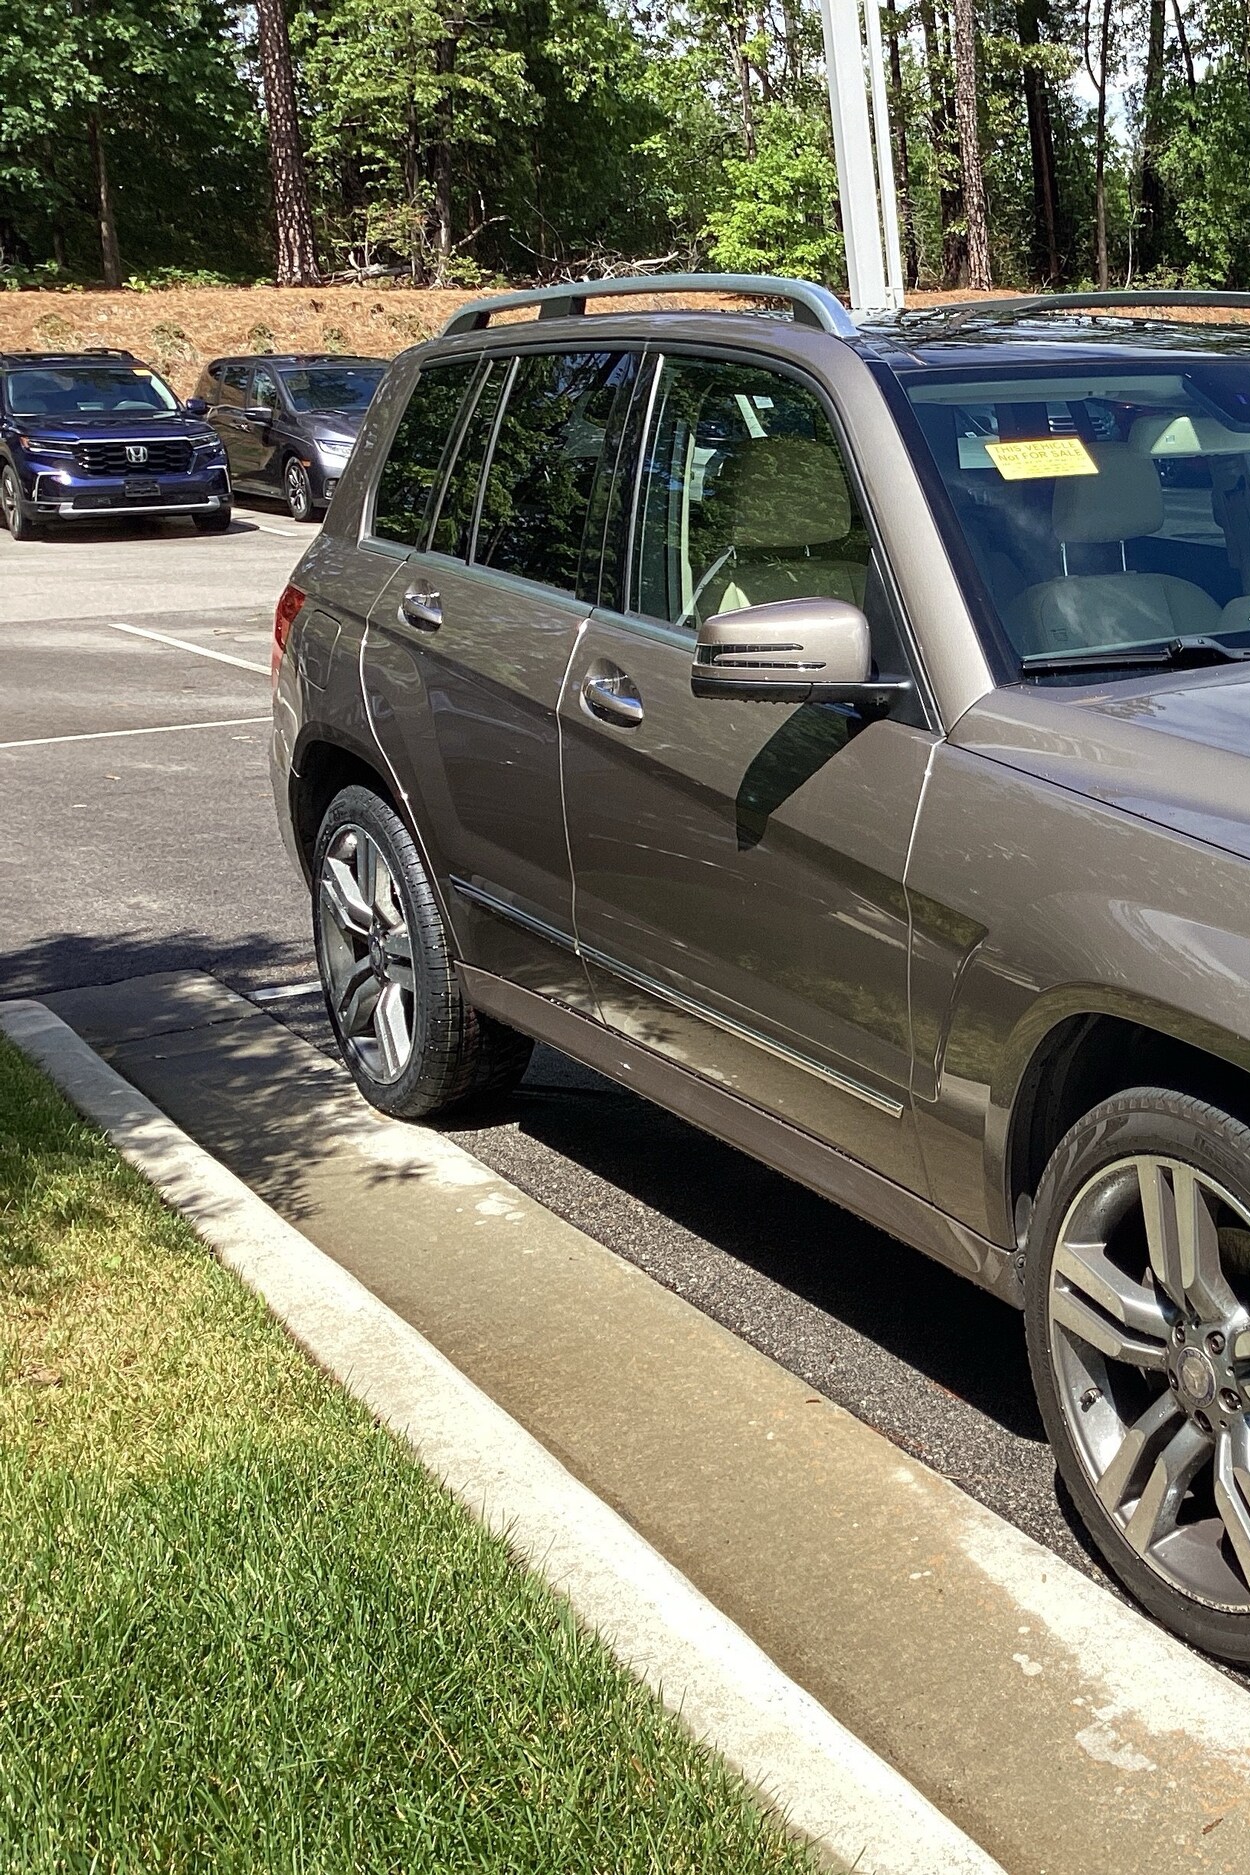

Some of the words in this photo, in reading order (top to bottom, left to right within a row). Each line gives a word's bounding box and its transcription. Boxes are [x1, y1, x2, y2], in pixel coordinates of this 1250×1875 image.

[993, 445, 1021, 454] THIS
[1024, 441, 1077, 451] VEHICLE
[1022, 451, 1047, 460] FOR
[1050, 449, 1082, 458] SALE
